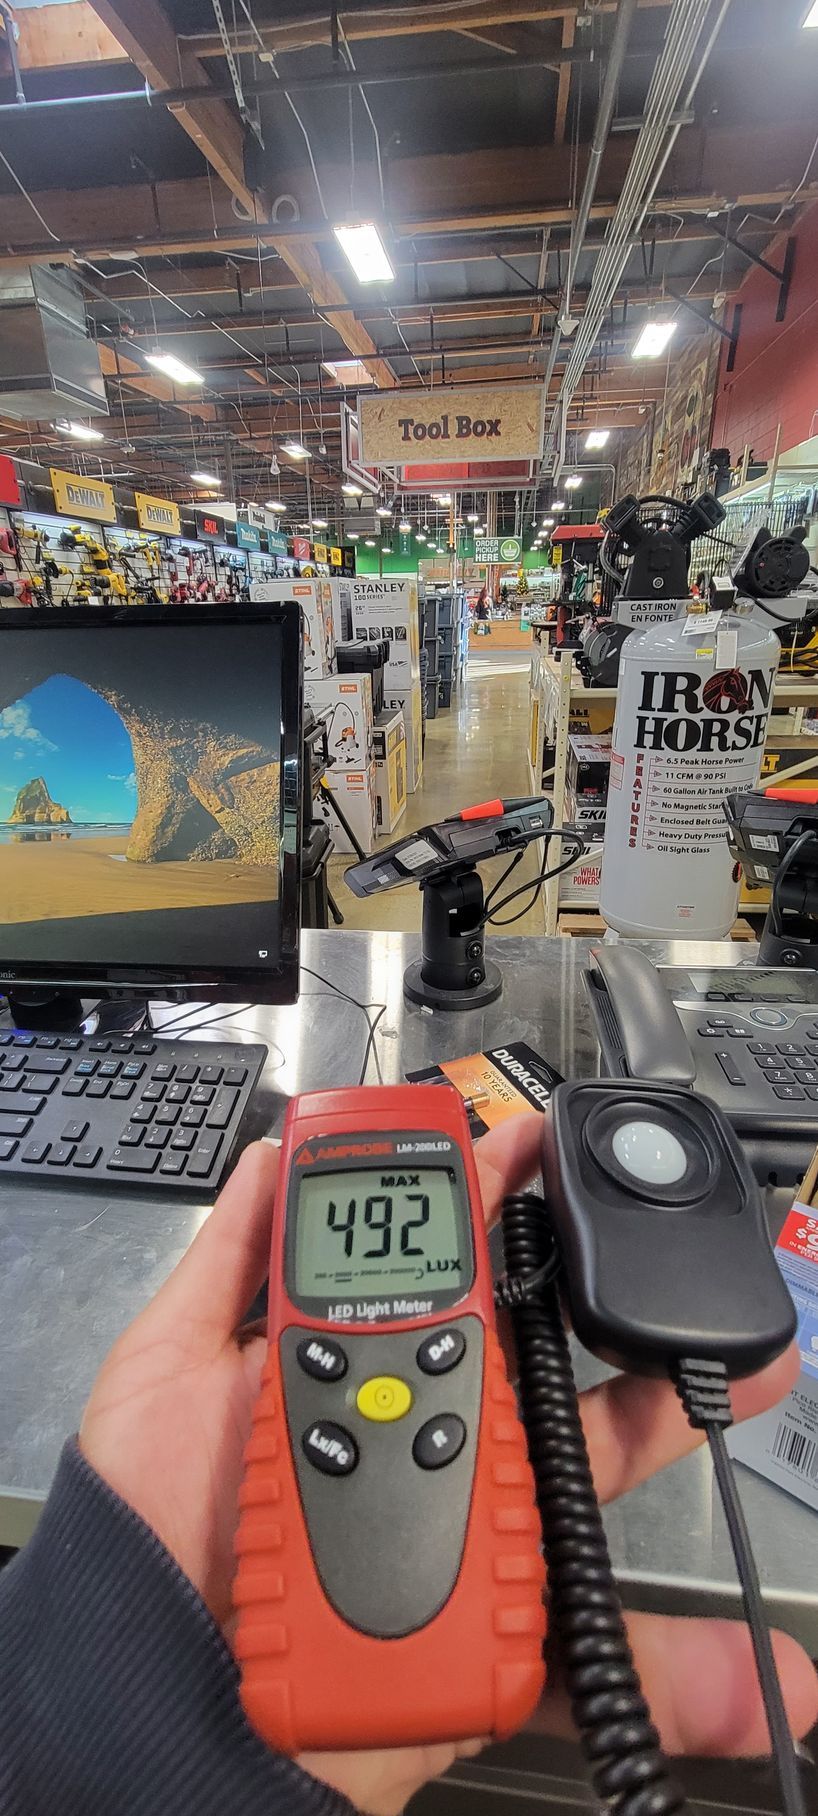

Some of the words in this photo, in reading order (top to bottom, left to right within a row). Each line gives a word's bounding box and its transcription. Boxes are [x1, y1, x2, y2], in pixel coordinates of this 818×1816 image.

[398, 415, 450, 441] Tool
[456, 416, 502, 438] Box
[204, 518, 218, 534] SKIL
[476, 546, 499, 554] PICKUP
[476, 554, 499, 562] HERE
[354, 583, 406, 594] STANLEY
[630, 603, 654, 612] CAST
[631, 614, 644, 622] EN
[645, 614, 674, 622] FONTE
[638, 667, 776, 714] IRON
[634, 712, 768, 752] HORSE
[676, 772, 694, 780] CFM
[708, 786, 724, 794] Tank
[673, 802, 707, 812] Magnetic
[708, 801, 722, 810] Star
[658, 832, 682, 840] Heavy
[684, 832, 702, 840] Duty
[704, 832, 727, 840] Pressu
[670, 846, 689, 854] Sight
[580, 867, 598, 876] WHAT
[574, 876, 600, 886] POWERS
[481, 1072, 492, 1080] 10
[489, 1080, 512, 1102] YEARS
[381, 1175, 420, 1187] MAX
[326, 1194, 430, 1258] 492
[426, 1259, 462, 1272] LUX
[328, 1304, 353, 1318] LED
[357, 1303, 390, 1318] Light
[394, 1300, 433, 1314] Meter
[428, 1334, 455, 1361] D-H
[306, 1342, 336, 1370] M-H
[785, 1411, 802, 1424] Item
[432, 1430, 448, 1448] R
[308, 1428, 349, 1466] Lx/Fc
